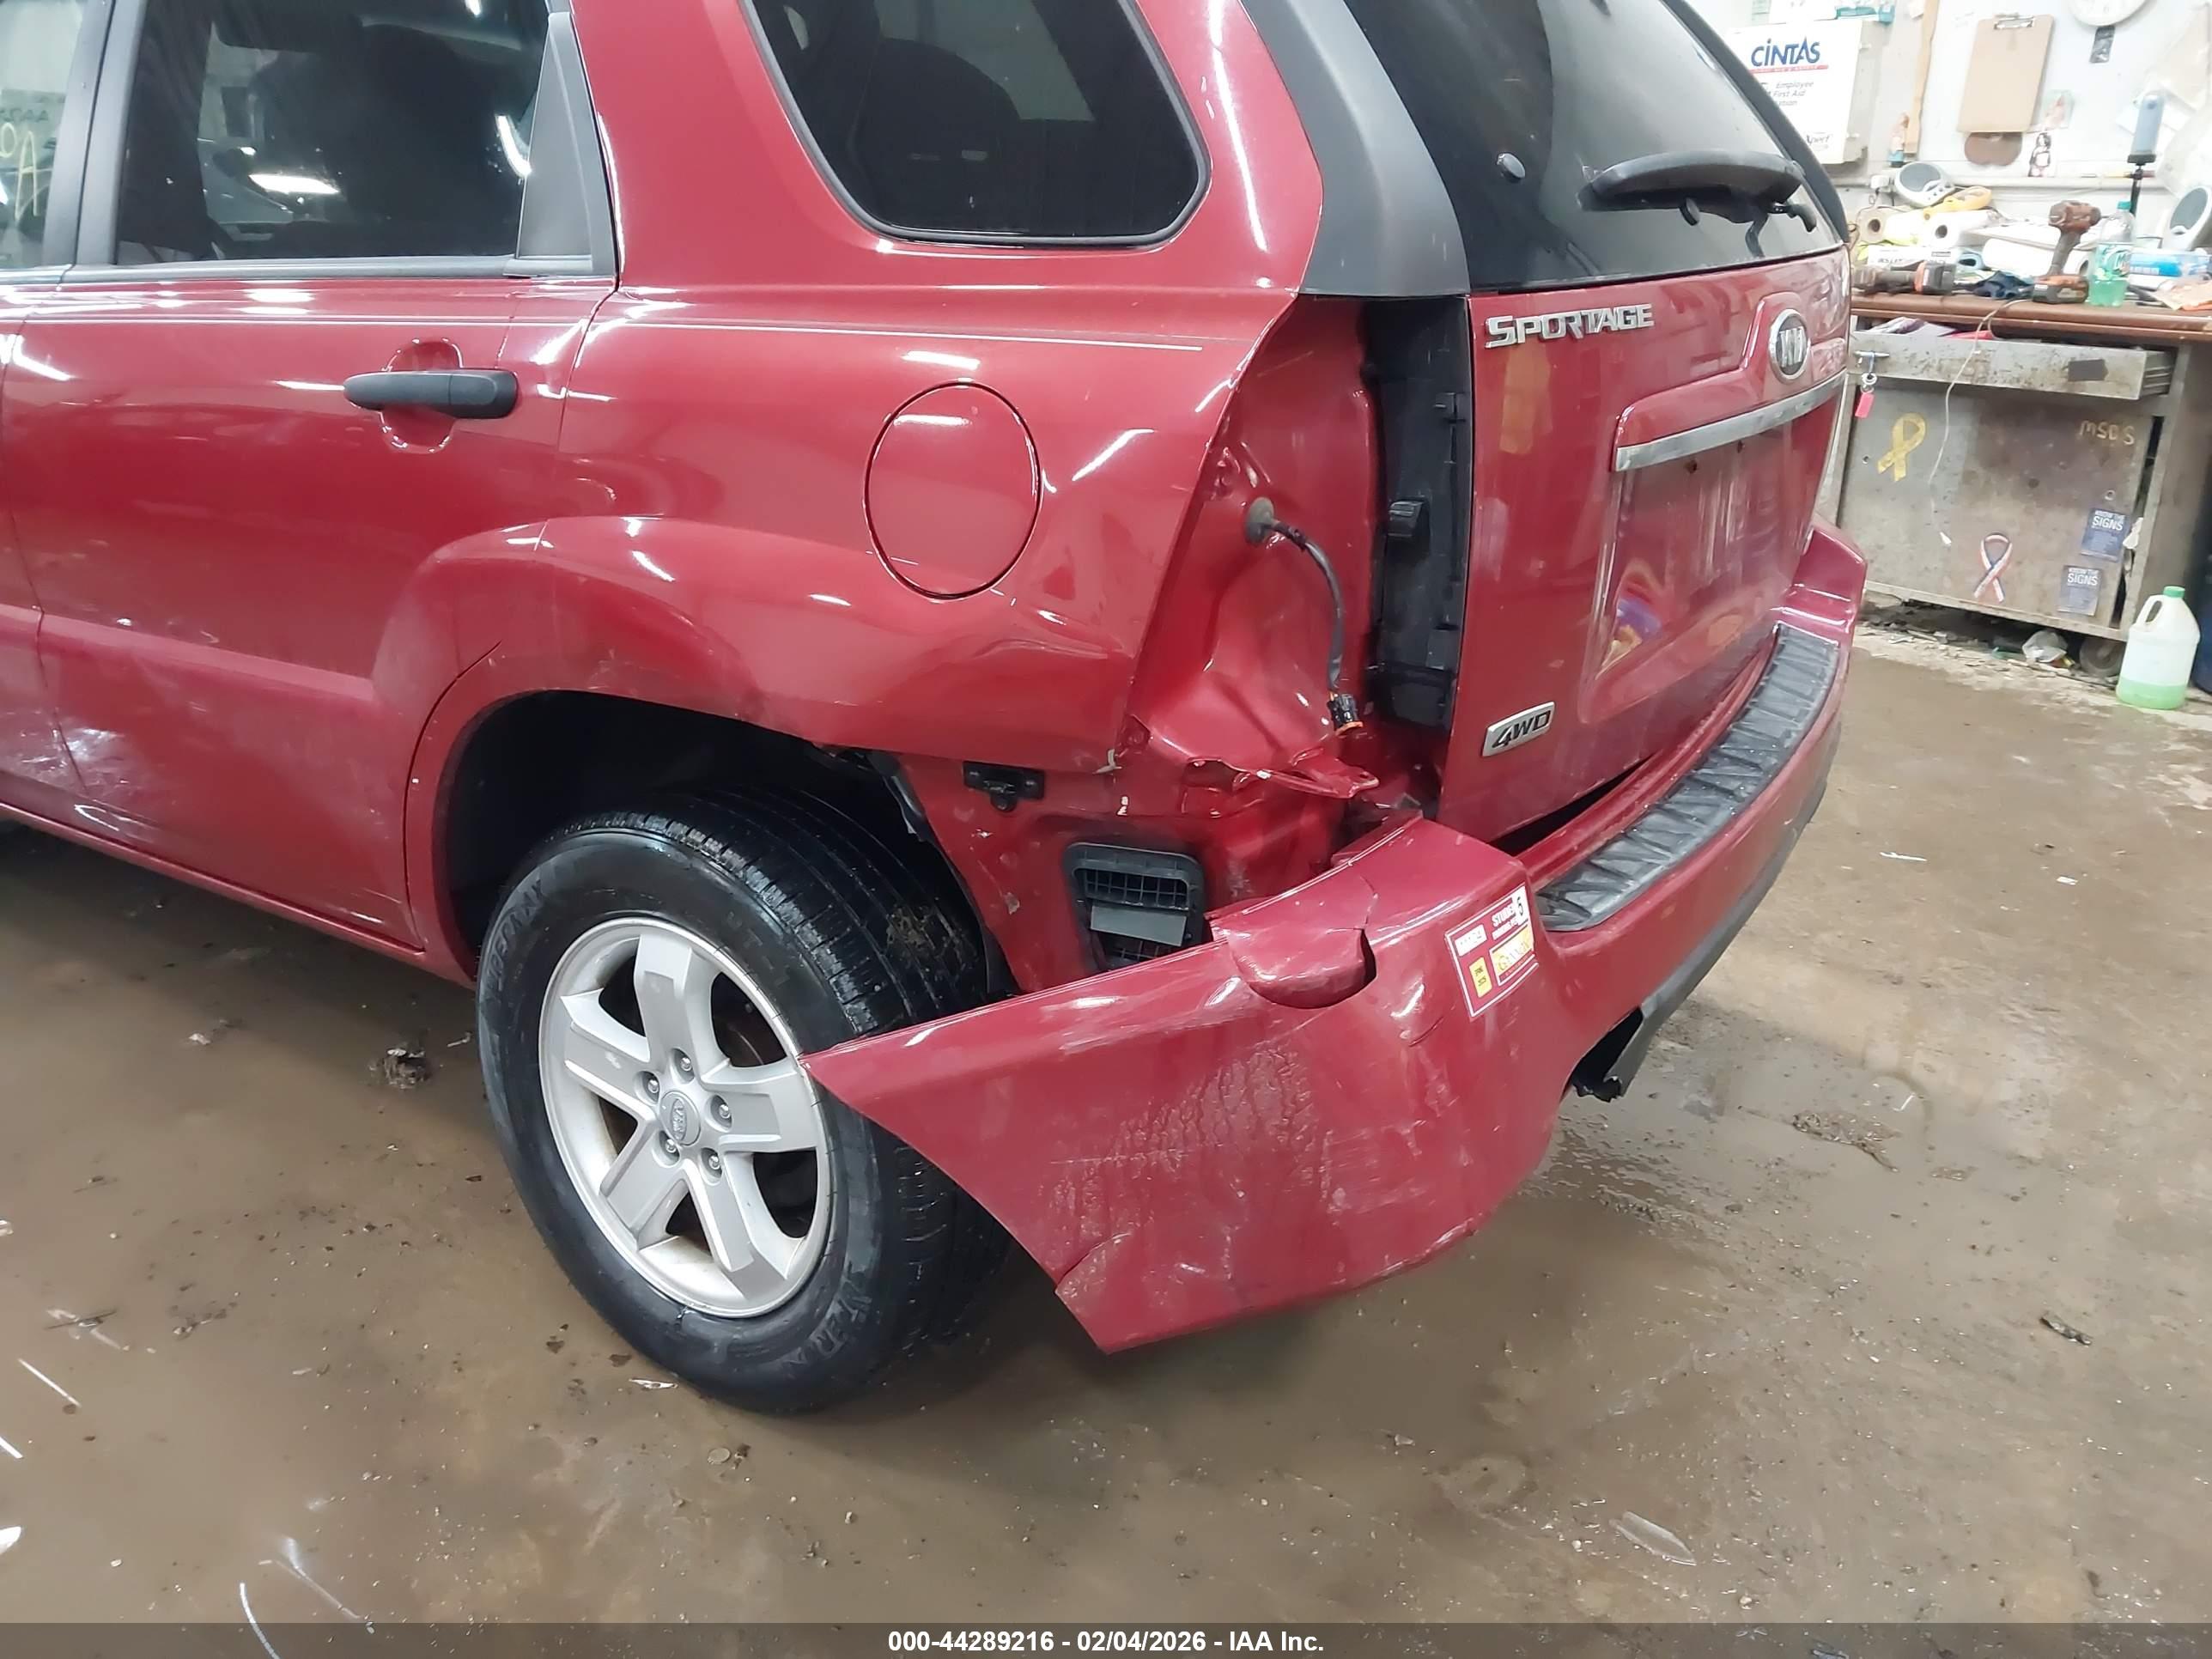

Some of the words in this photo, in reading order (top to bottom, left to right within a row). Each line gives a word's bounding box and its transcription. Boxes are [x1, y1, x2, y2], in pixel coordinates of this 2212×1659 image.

[1485, 303, 1655, 349] SPORTAGE
[2092, 516, 2124, 531] SIGNS
[2067, 573, 2098, 586] SIGNS
[1492, 710, 1551, 748] 4WD
